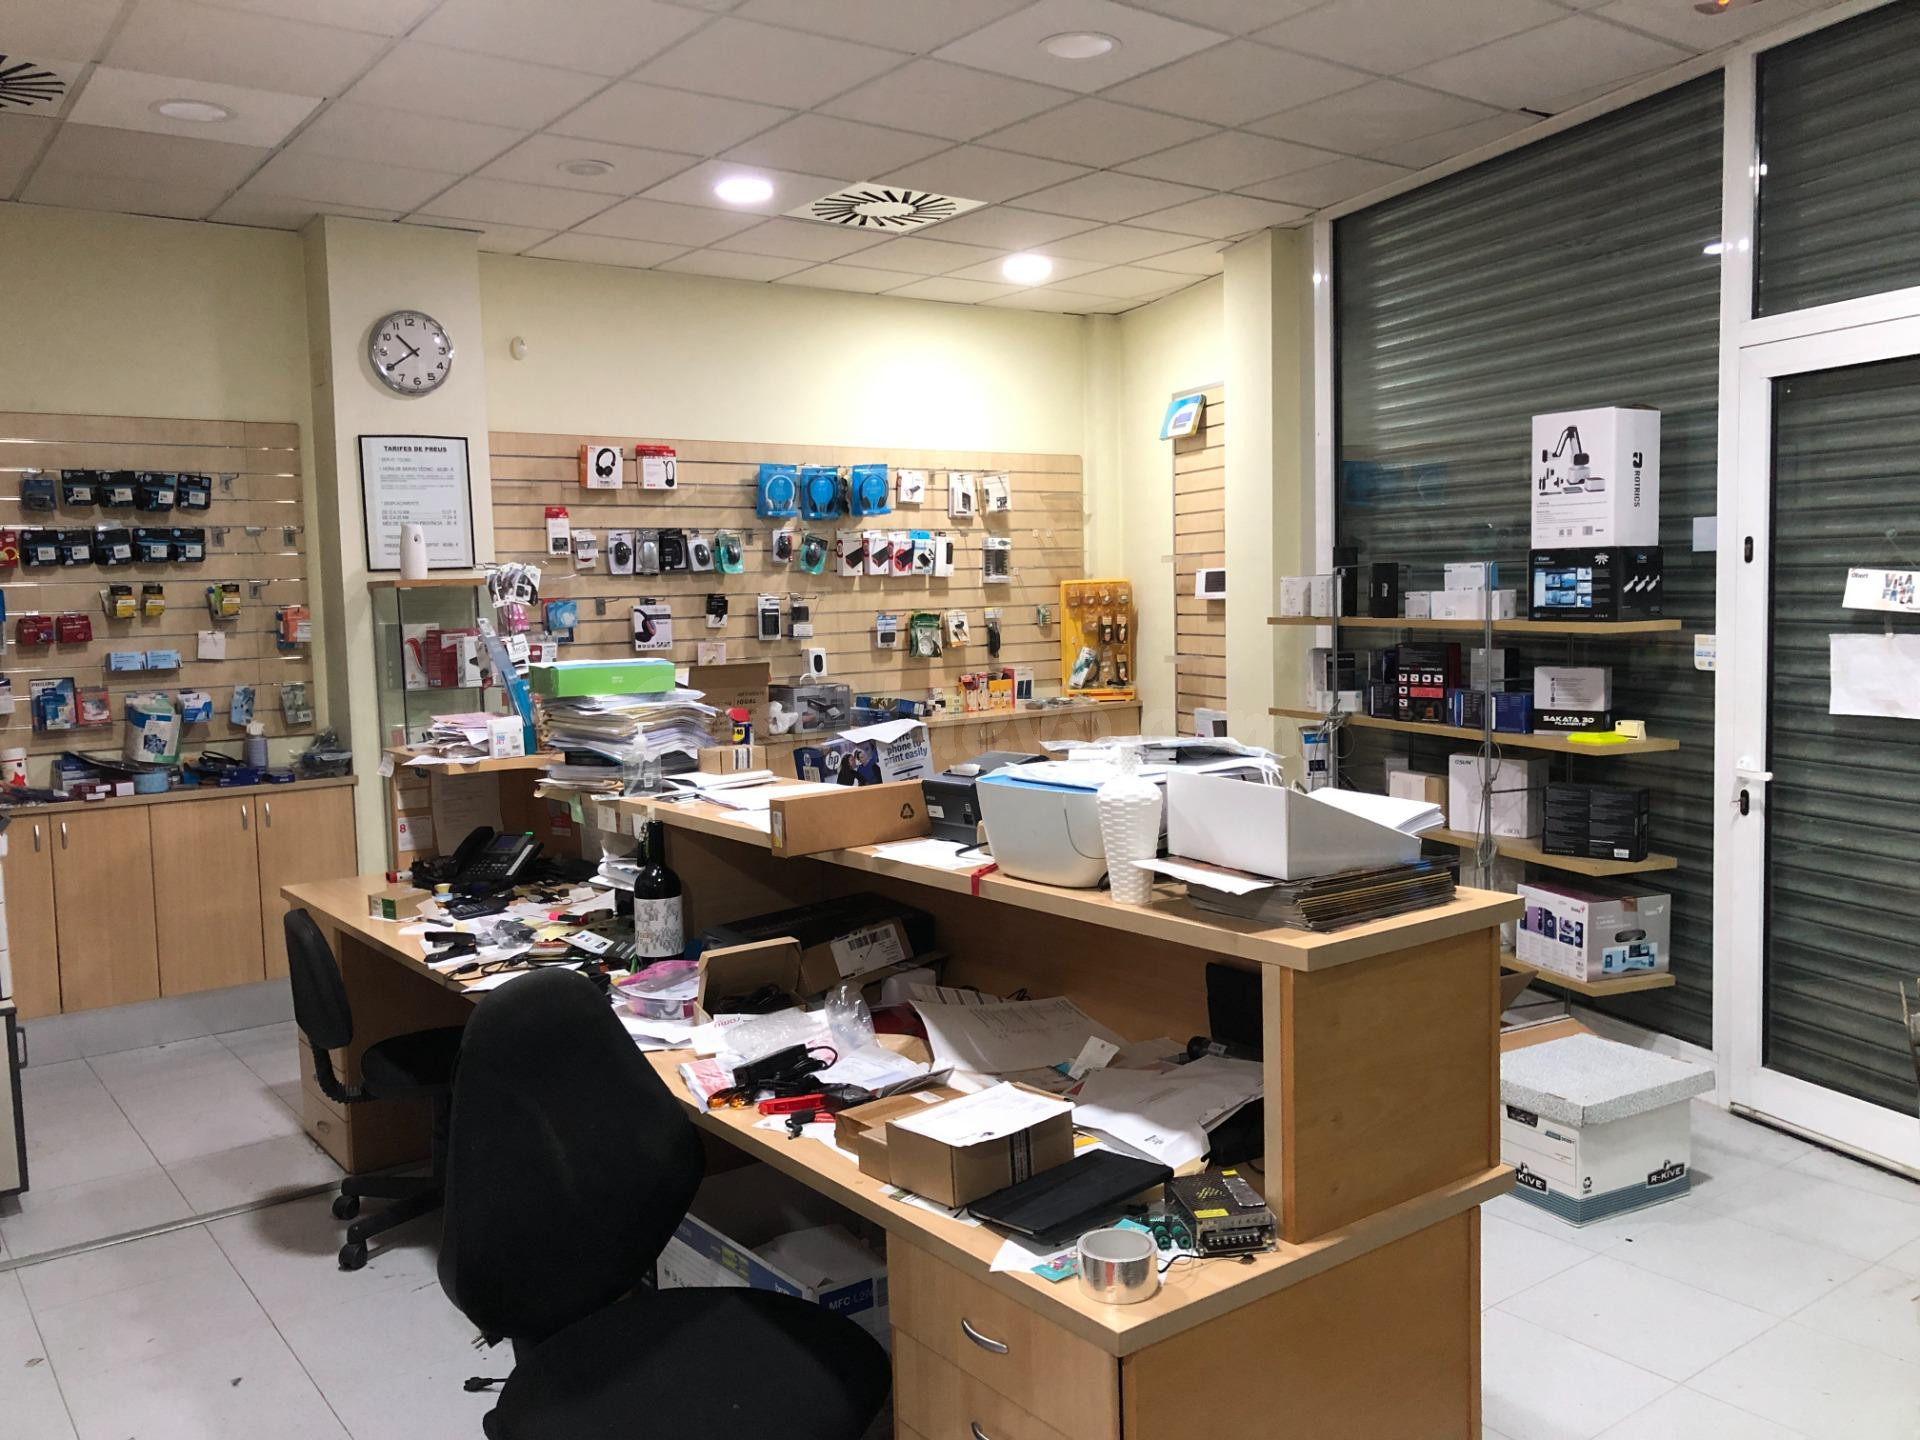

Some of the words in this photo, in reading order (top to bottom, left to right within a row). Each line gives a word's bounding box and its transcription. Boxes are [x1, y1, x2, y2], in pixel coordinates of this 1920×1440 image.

[392, 322, 400, 331] 11
[404, 318, 415, 327] 12
[382, 333, 391, 341] 10
[438, 347, 447, 355] 3
[436, 362, 444, 370] 4
[398, 373, 406, 382] 7
[413, 377, 422, 386] 6
[427, 373, 436, 381] 5
[1633, 470, 1641, 508] ROTRICS
[1543, 715, 1580, 724] SAKATA
[887, 742, 912, 755] phone
[884, 753, 904, 767] print
[905, 747, 928, 759] easily
[399, 823, 407, 833] 8
[1650, 1167, 1681, 1183] R-KIVE
[1517, 1172, 1543, 1188] KIVE
